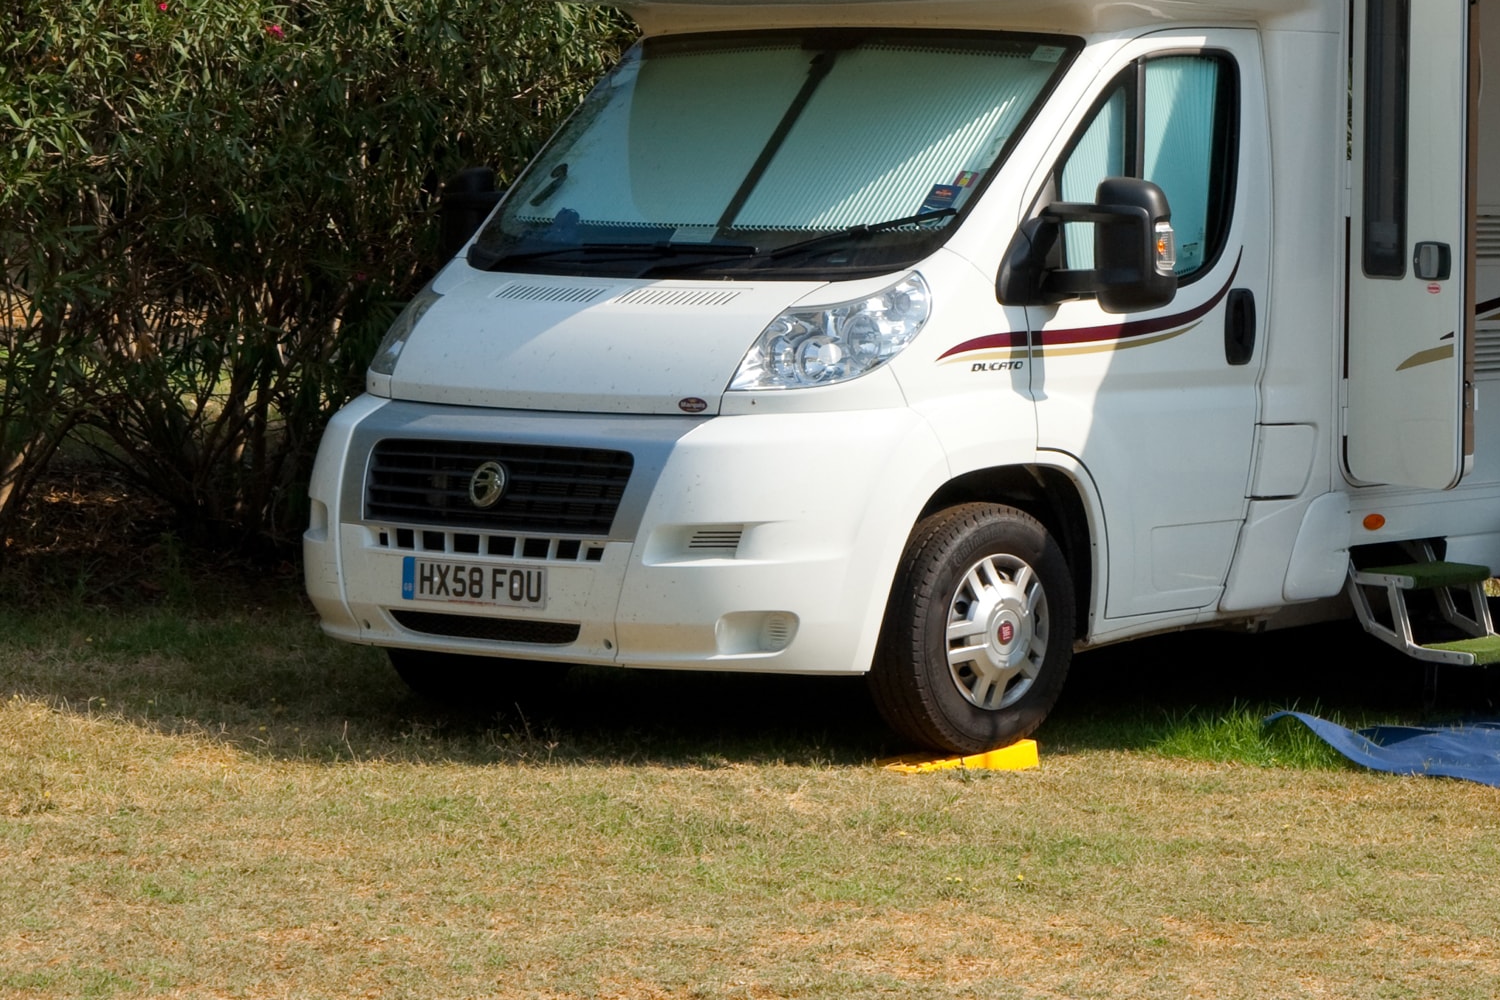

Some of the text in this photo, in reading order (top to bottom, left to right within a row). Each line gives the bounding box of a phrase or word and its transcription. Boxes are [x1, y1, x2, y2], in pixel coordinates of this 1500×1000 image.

[971, 360, 1024, 372] DUCATO
[419, 563, 542, 603] HX58 FOU
